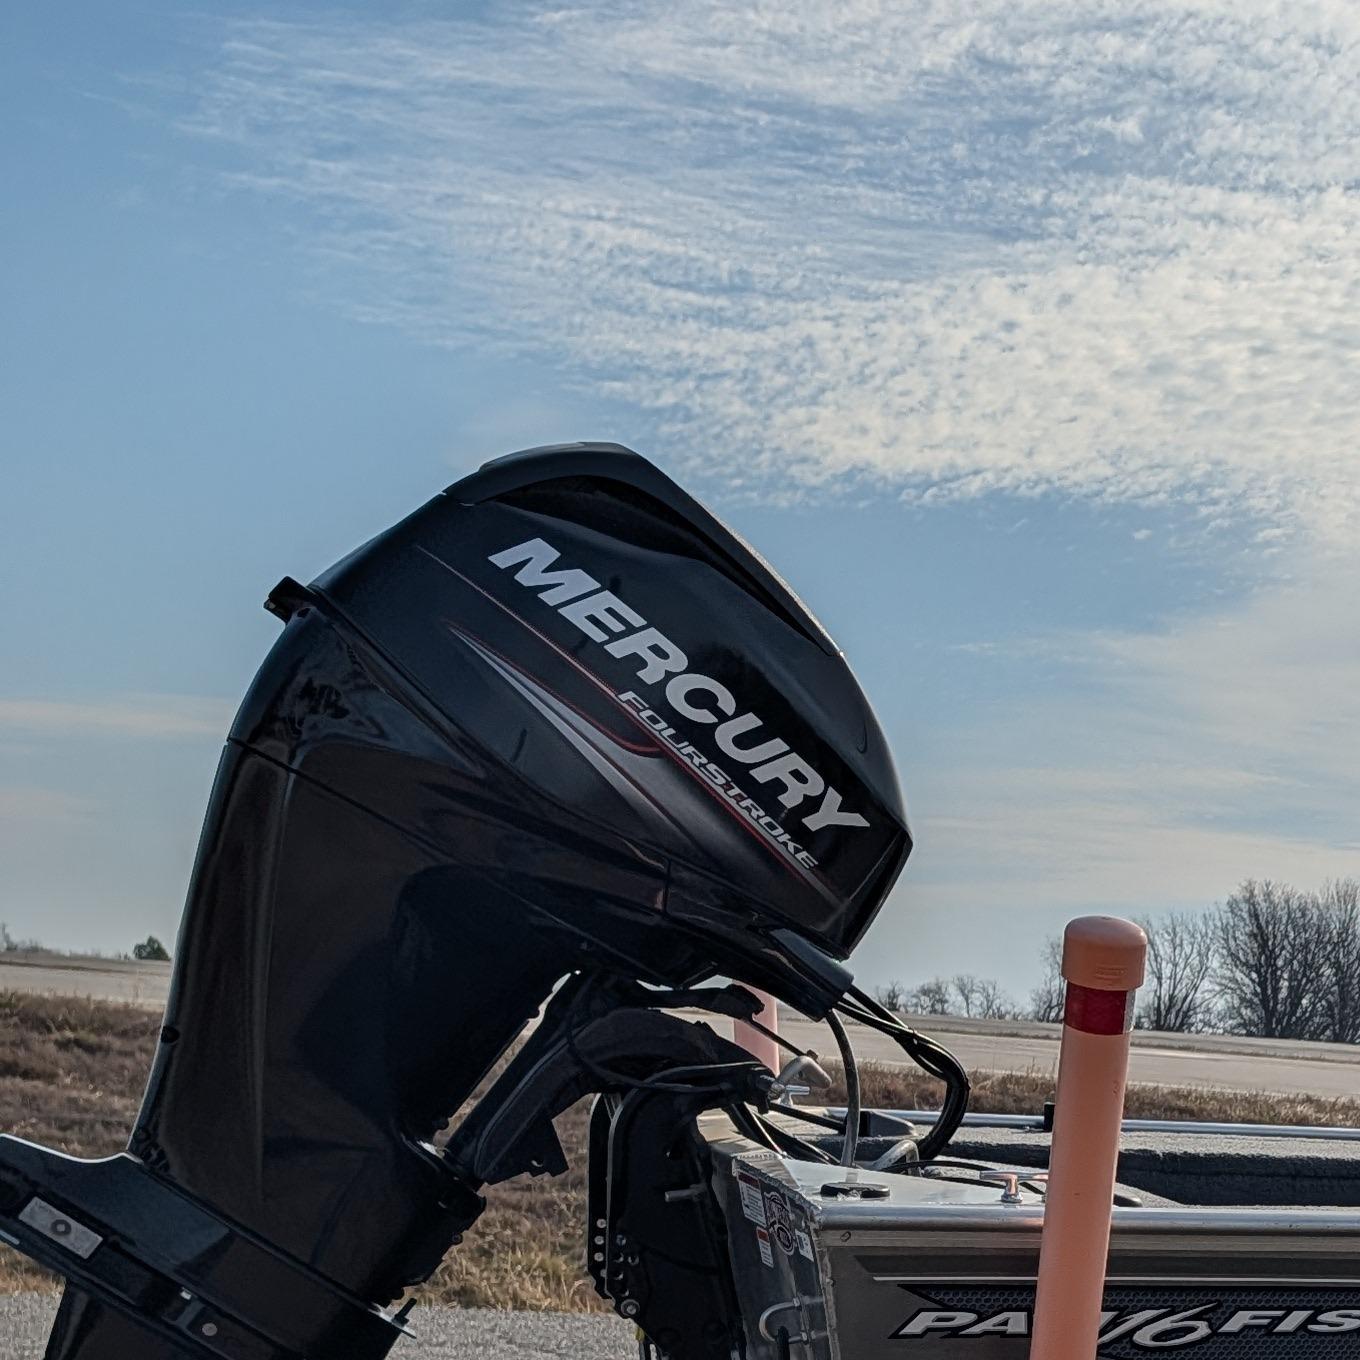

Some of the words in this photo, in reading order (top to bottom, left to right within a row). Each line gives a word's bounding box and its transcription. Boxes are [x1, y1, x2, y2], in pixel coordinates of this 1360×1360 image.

[487, 537, 871, 833] MERCURY
[615, 690, 819, 872] FOURSTROKE
[1097, 1302, 1218, 1347] 16
